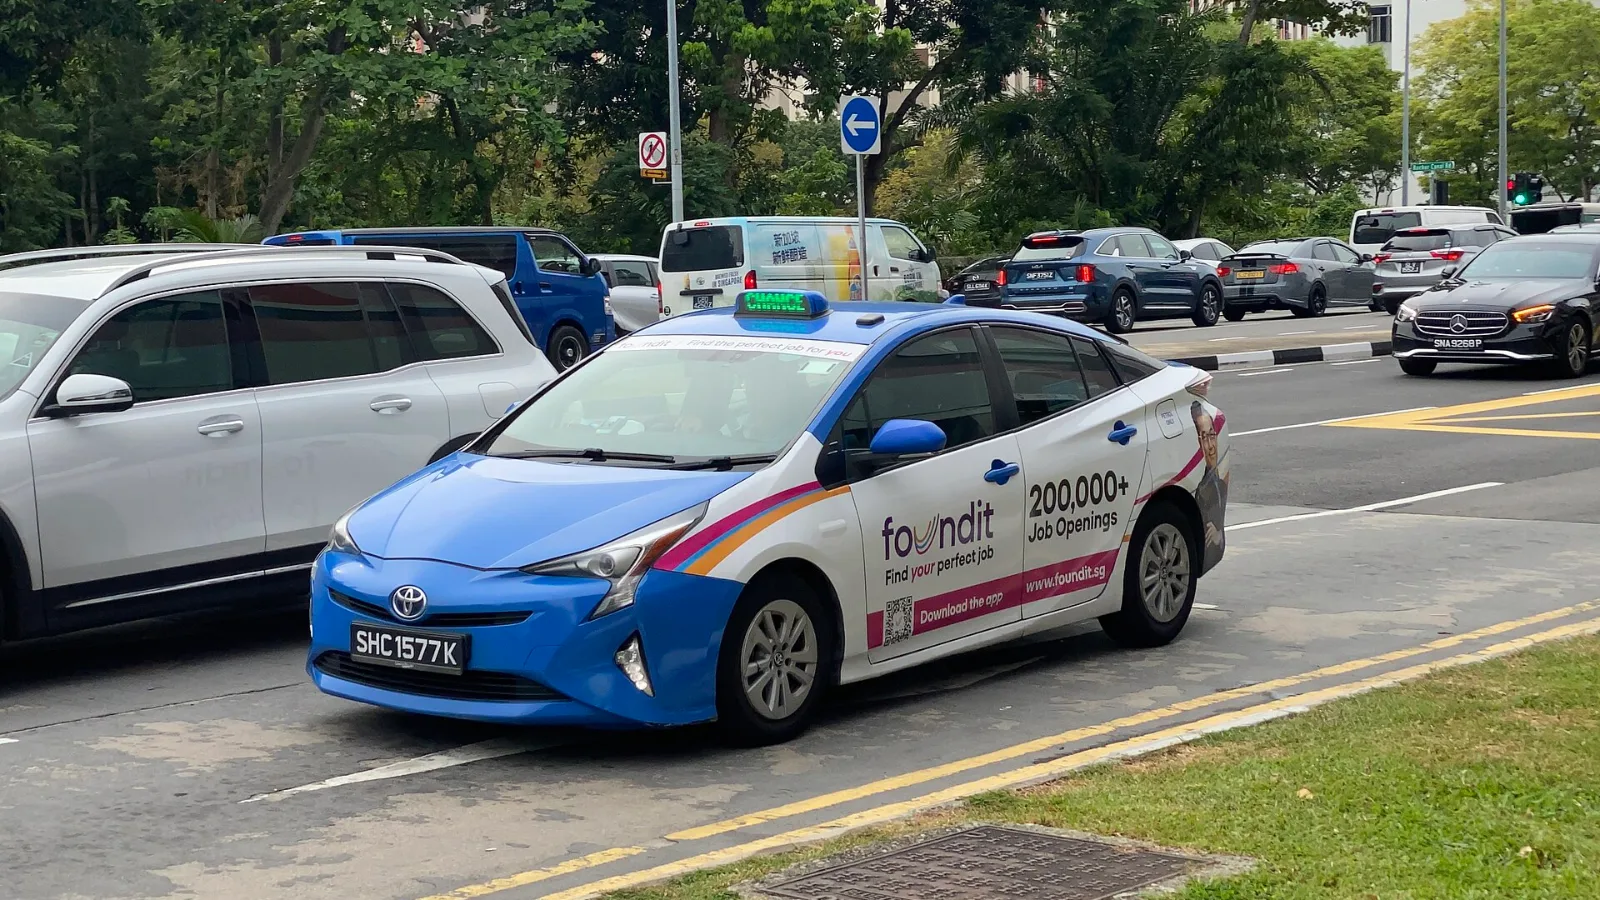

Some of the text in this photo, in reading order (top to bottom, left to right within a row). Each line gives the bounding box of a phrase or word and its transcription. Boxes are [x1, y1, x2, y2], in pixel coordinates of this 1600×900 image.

[773, 230, 800, 247] 新加坡
[772, 246, 808, 265] 新鲜酿造
[718, 276, 742, 287] SINGAPORE
[687, 338, 713, 347] Find
[714, 339, 735, 348] the
[735, 341, 784, 351] perfect
[782, 342, 805, 353] job
[806, 345, 825, 354] for
[1433, 339, 1482, 348] SNA9268P
[1029, 470, 1129, 518] 200,000+
[882, 499, 994, 560] foundit
[1028, 510, 1118, 543] Job Openings
[885, 545, 994, 586] Find your perfect job
[1025, 565, 1106, 593] www.foundit.sg
[920, 592, 1004, 625] Download the app
[356, 630, 457, 665] SHC1577K
